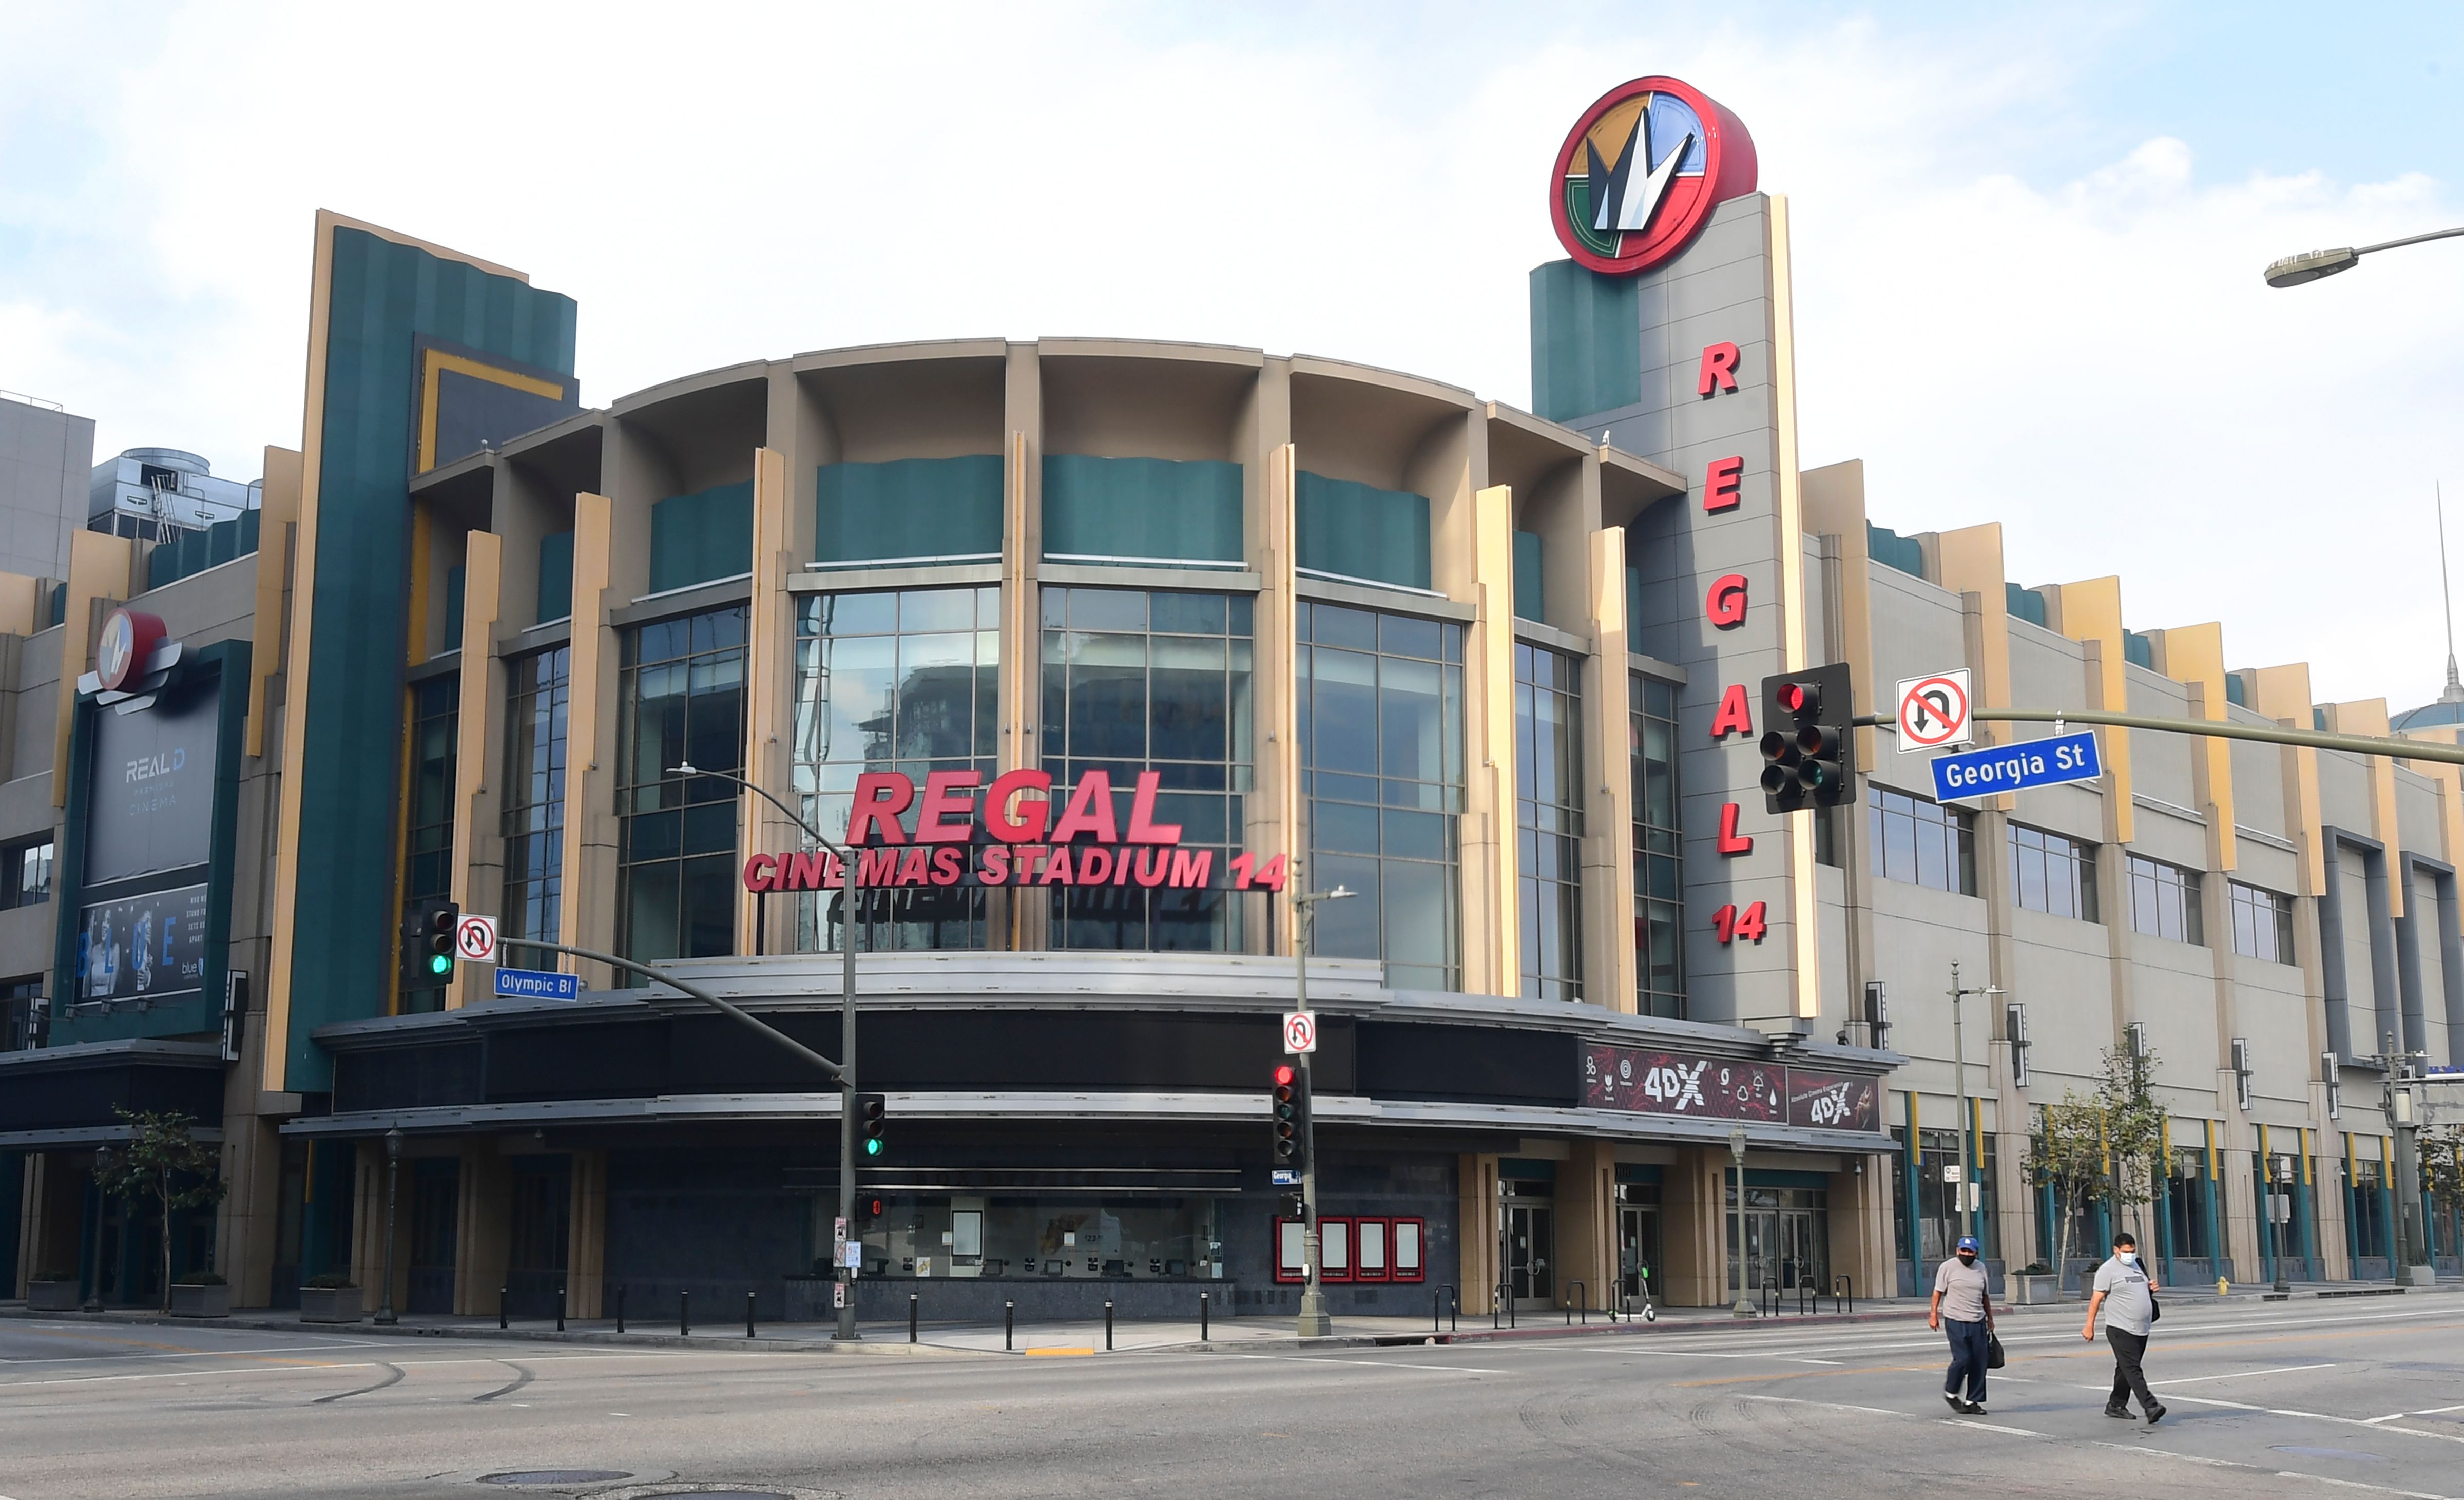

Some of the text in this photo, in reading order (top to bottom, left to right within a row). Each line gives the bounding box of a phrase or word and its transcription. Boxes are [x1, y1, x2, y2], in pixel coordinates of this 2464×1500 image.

[1698, 341, 1754, 854] REGAL
[126, 753, 170, 783] REAL
[1946, 744, 2085, 787] Georgia St
[129, 795, 176, 816] CINEMA
[845, 768, 1182, 845] REGAL
[743, 847, 1286, 892] CINEMAS STADIUM 14
[1712, 901, 1767, 944] 14
[76, 916, 176, 978] BLUE
[182, 961, 197, 974] blue
[502, 974, 571, 993] Olympic Bl
[1644, 1060, 1707, 1110] 4DX
[1811, 1082, 1851, 1124] 4DX
